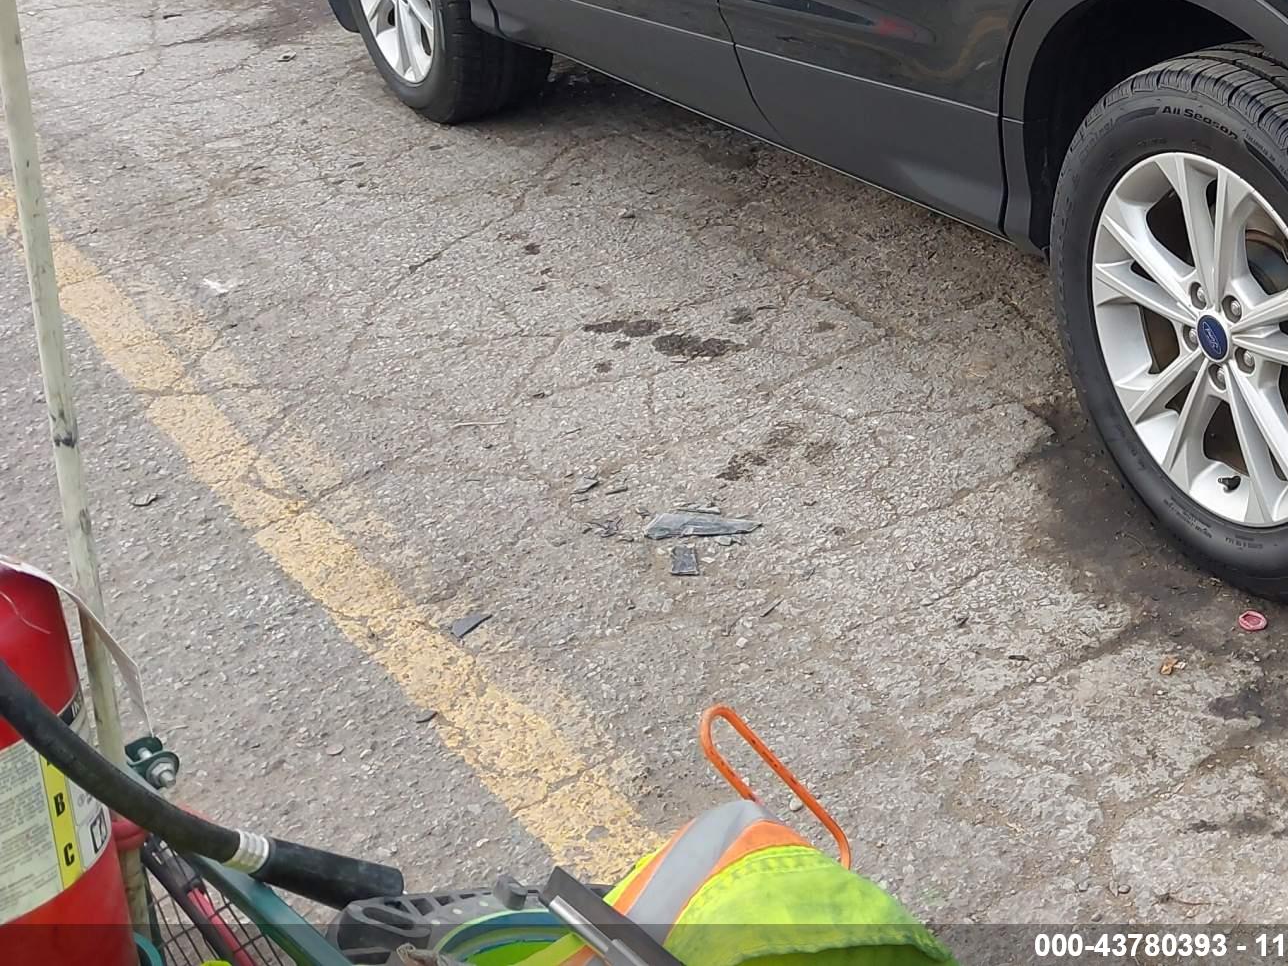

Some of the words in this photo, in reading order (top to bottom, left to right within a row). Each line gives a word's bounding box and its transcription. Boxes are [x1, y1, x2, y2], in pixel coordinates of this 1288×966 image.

[1162, 105, 1181, 116] All
[1183, 108, 1239, 140] Season
[53, 791, 66, 818] B
[63, 842, 76, 867] C
